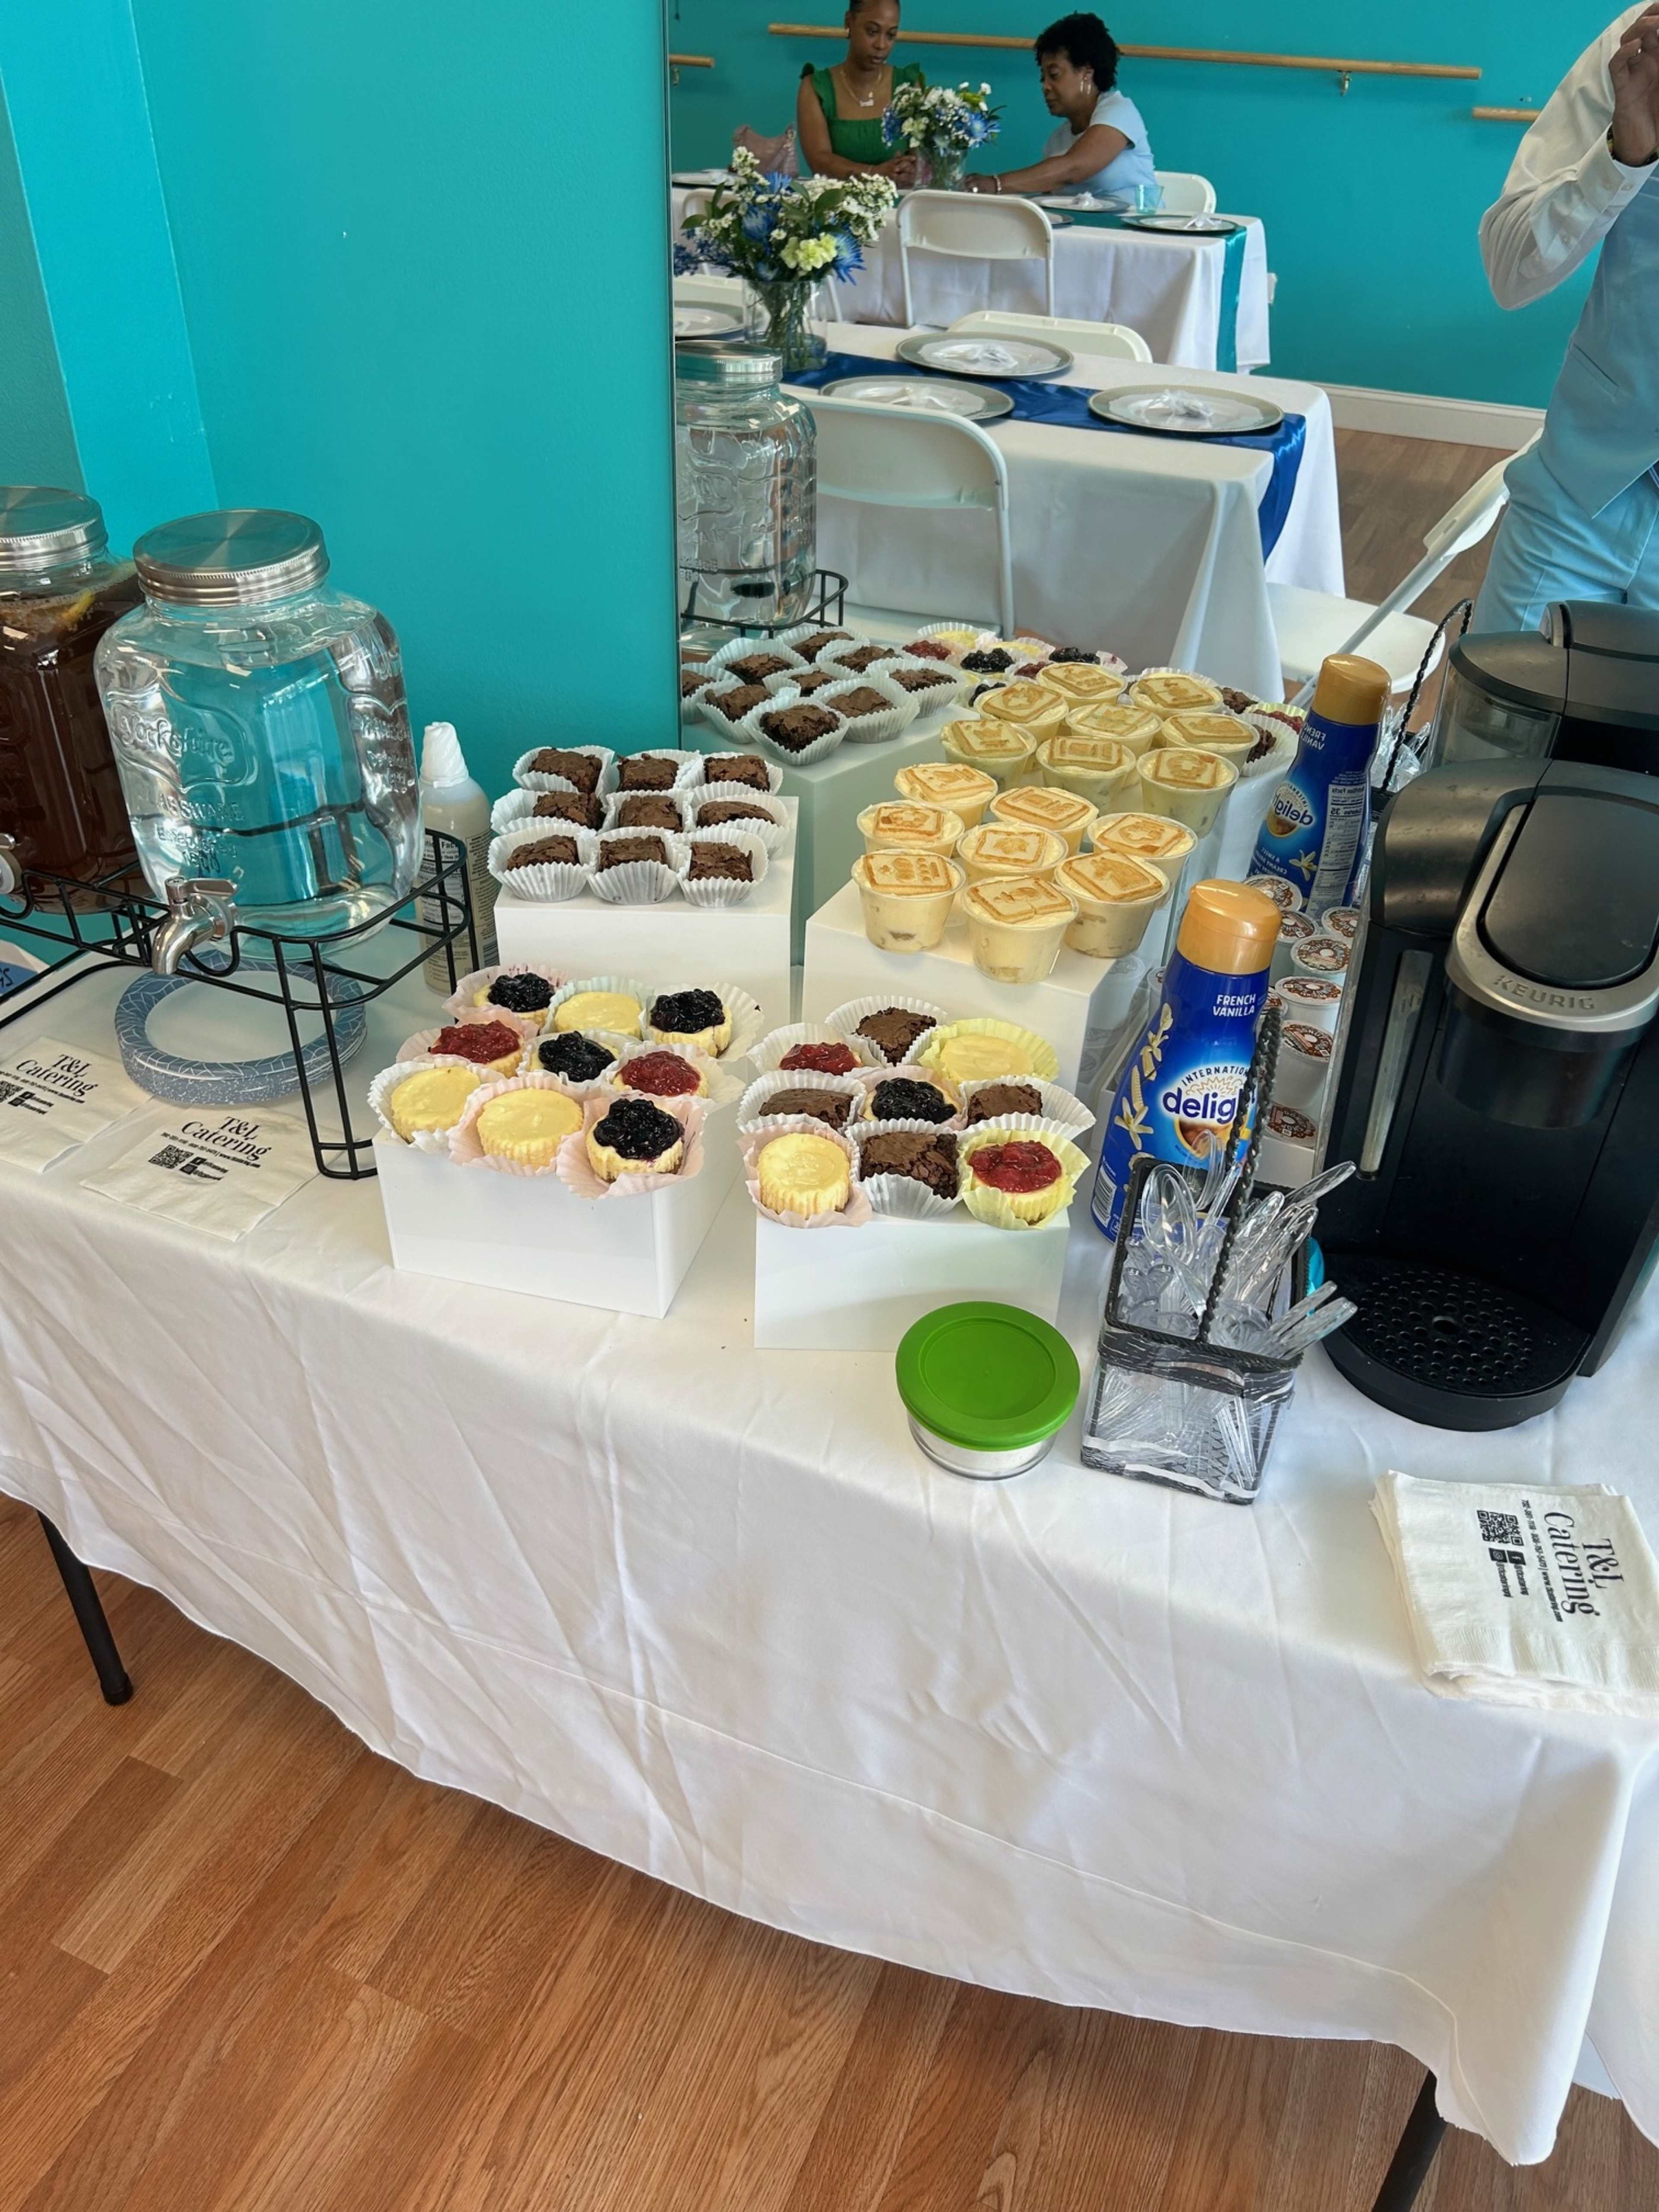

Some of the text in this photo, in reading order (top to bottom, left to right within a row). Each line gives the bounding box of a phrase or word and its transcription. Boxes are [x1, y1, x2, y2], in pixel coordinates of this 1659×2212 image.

[1217, 993, 1256, 1006] FRENCH
[1494, 975, 1595, 1010] KEURIG
[1213, 1004, 1255, 1017] VANILLA
[16, 1059, 98, 1097] Catering
[52, 1054, 89, 1077] T&L
[1181, 1065, 1250, 1087] INTERNATION
[1162, 1087, 1244, 1125] delig
[181, 1121, 271, 1161] Catering
[217, 1116, 262, 1140] T&L
[1543, 1512, 1601, 1617] Catering
[1582, 1538, 1624, 1589] T&L
